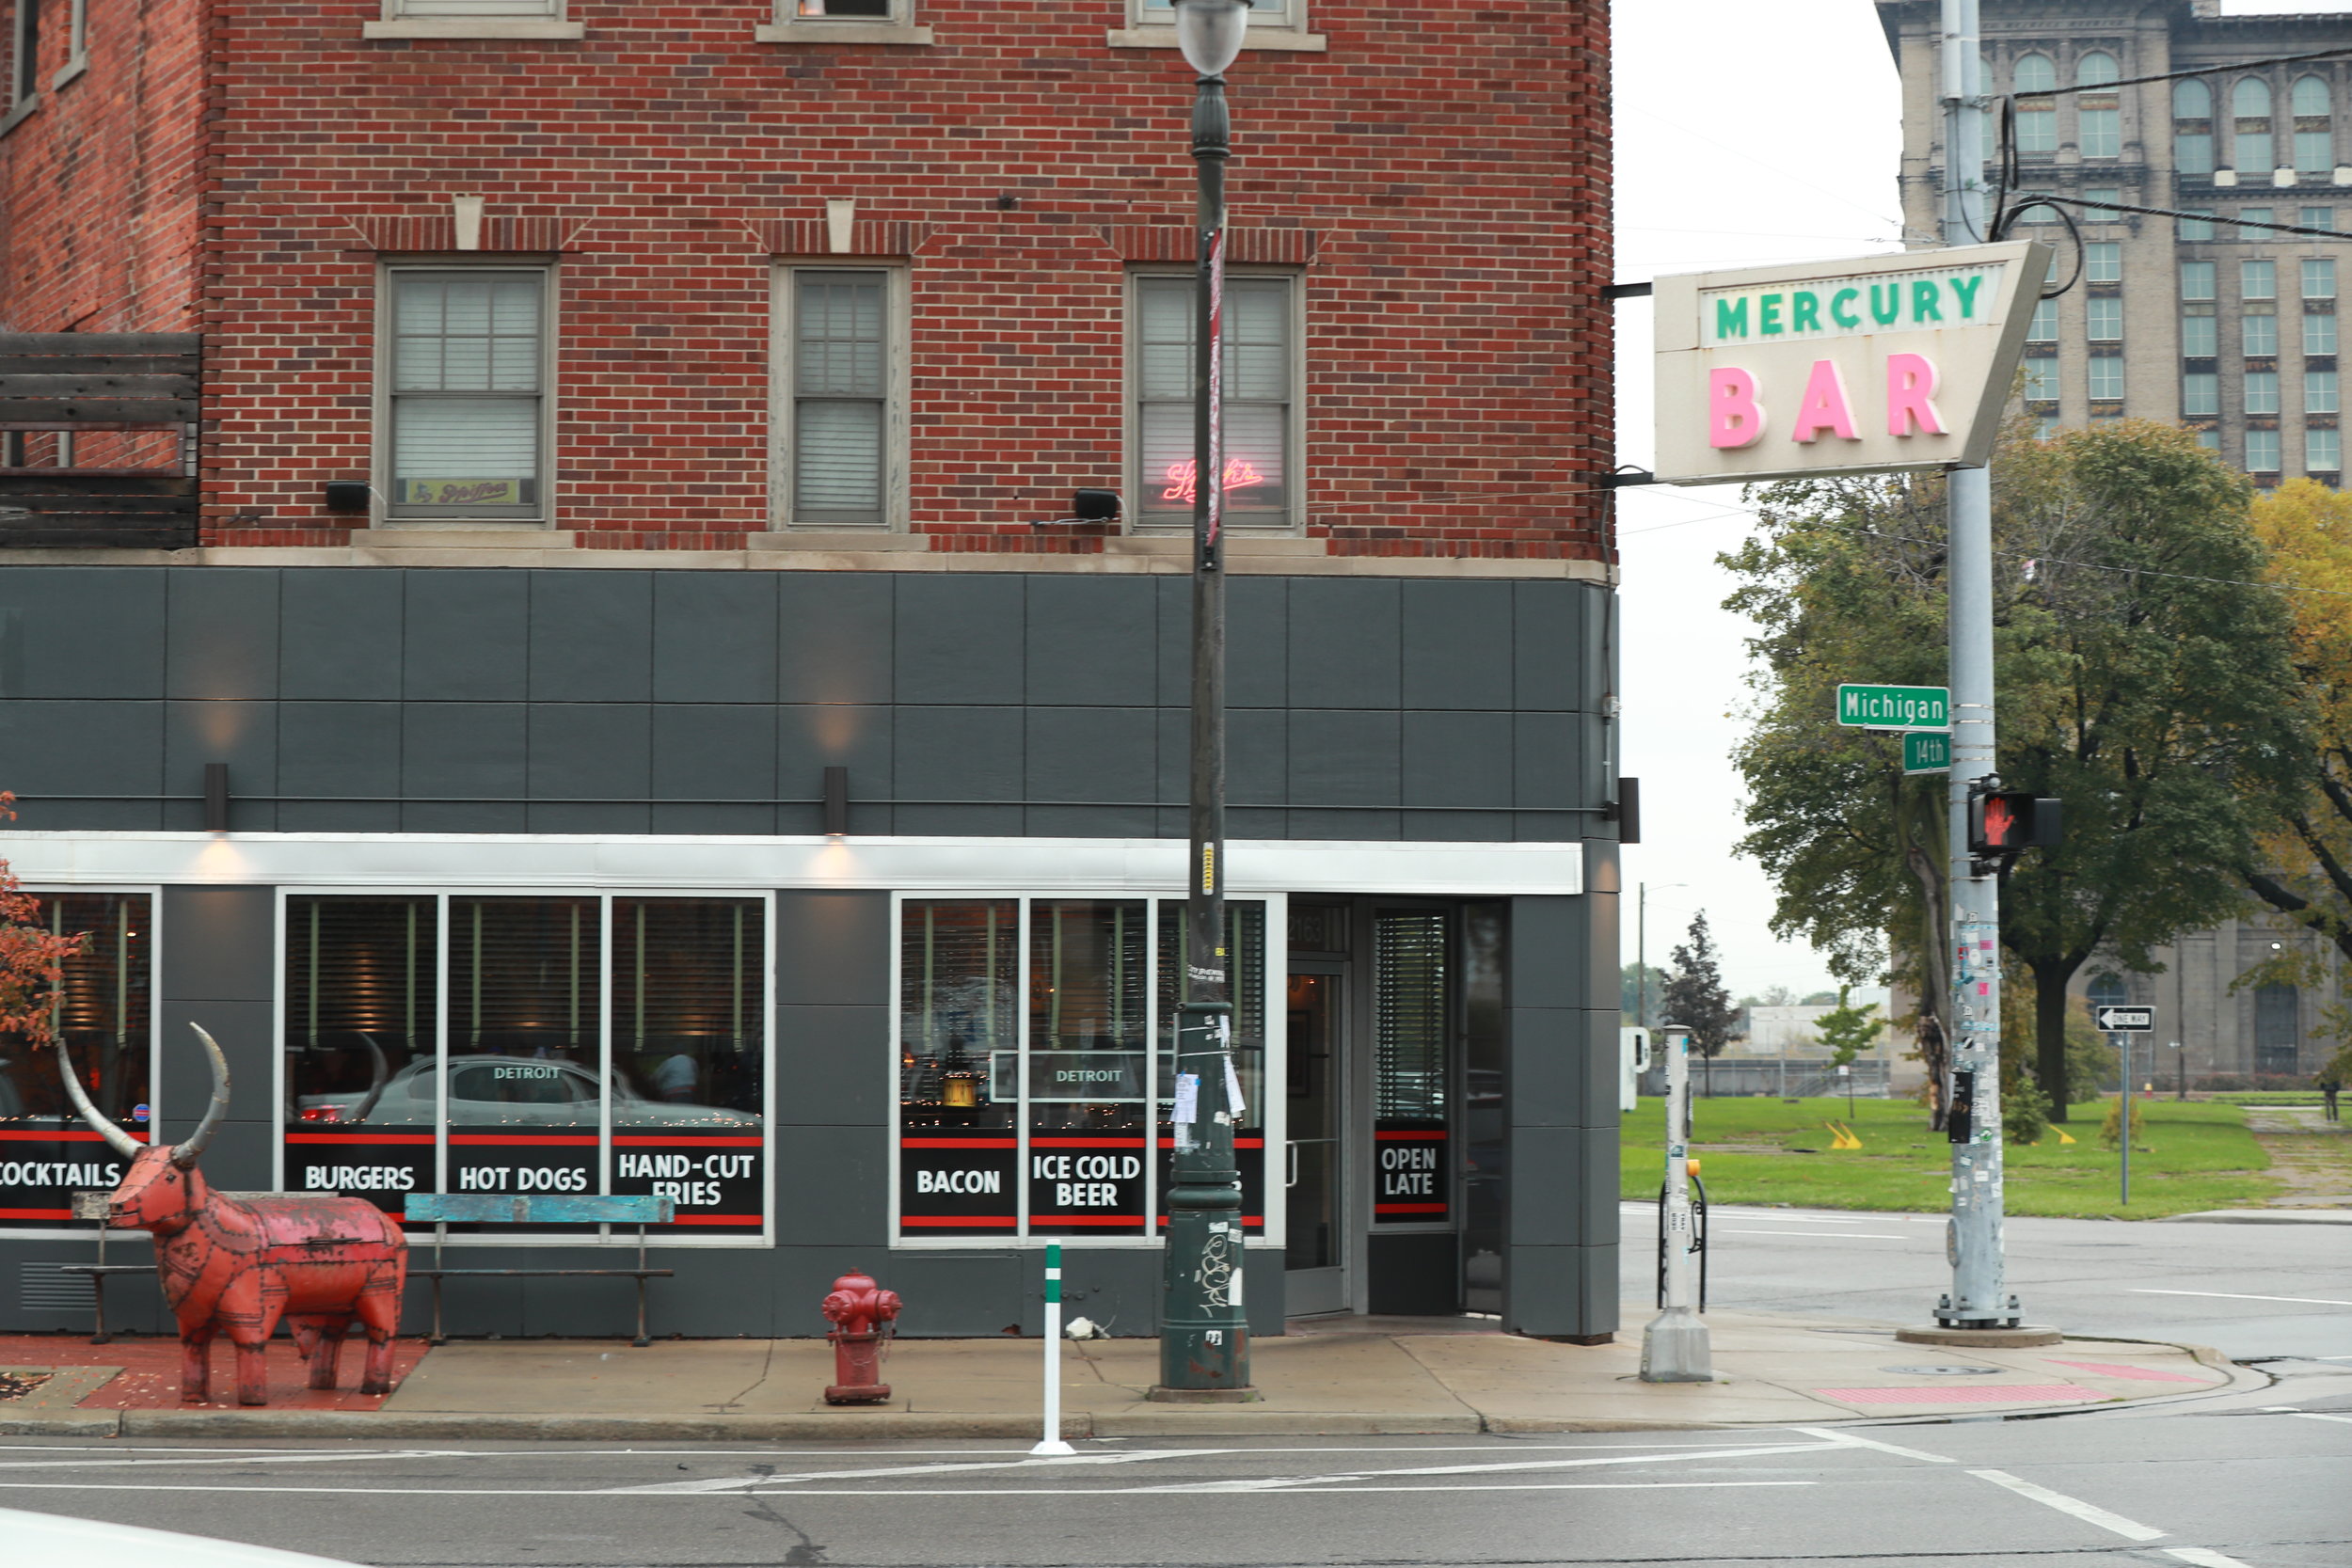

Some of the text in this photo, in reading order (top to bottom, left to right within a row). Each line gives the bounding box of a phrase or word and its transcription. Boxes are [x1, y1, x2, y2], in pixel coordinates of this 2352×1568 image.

[1716, 276, 1981, 339] MERCURY
[1709, 354, 1948, 450] BAR
[1846, 692, 1943, 723] Michigan
[1915, 739, 1944, 764] 14th
[2112, 1014, 2146, 1023] ONE WAY
[494, 1067, 561, 1080] DETROIT
[1056, 1069, 1122, 1082] DETROIT
[619, 1154, 755, 1179] HAND-CUT
[1033, 1155, 1140, 1180] ICE COLD
[1381, 1148, 1436, 1170] OPEN
[0, 1162, 121, 1187] OCKTAILS
[305, 1165, 415, 1190] BURGERS
[460, 1166, 587, 1191] HOT DOGS
[916, 1170, 1000, 1194] BACON
[1385, 1173, 1433, 1195] LATE
[652, 1181, 722, 1206] FRIES
[1056, 1183, 1118, 1206] BEER
